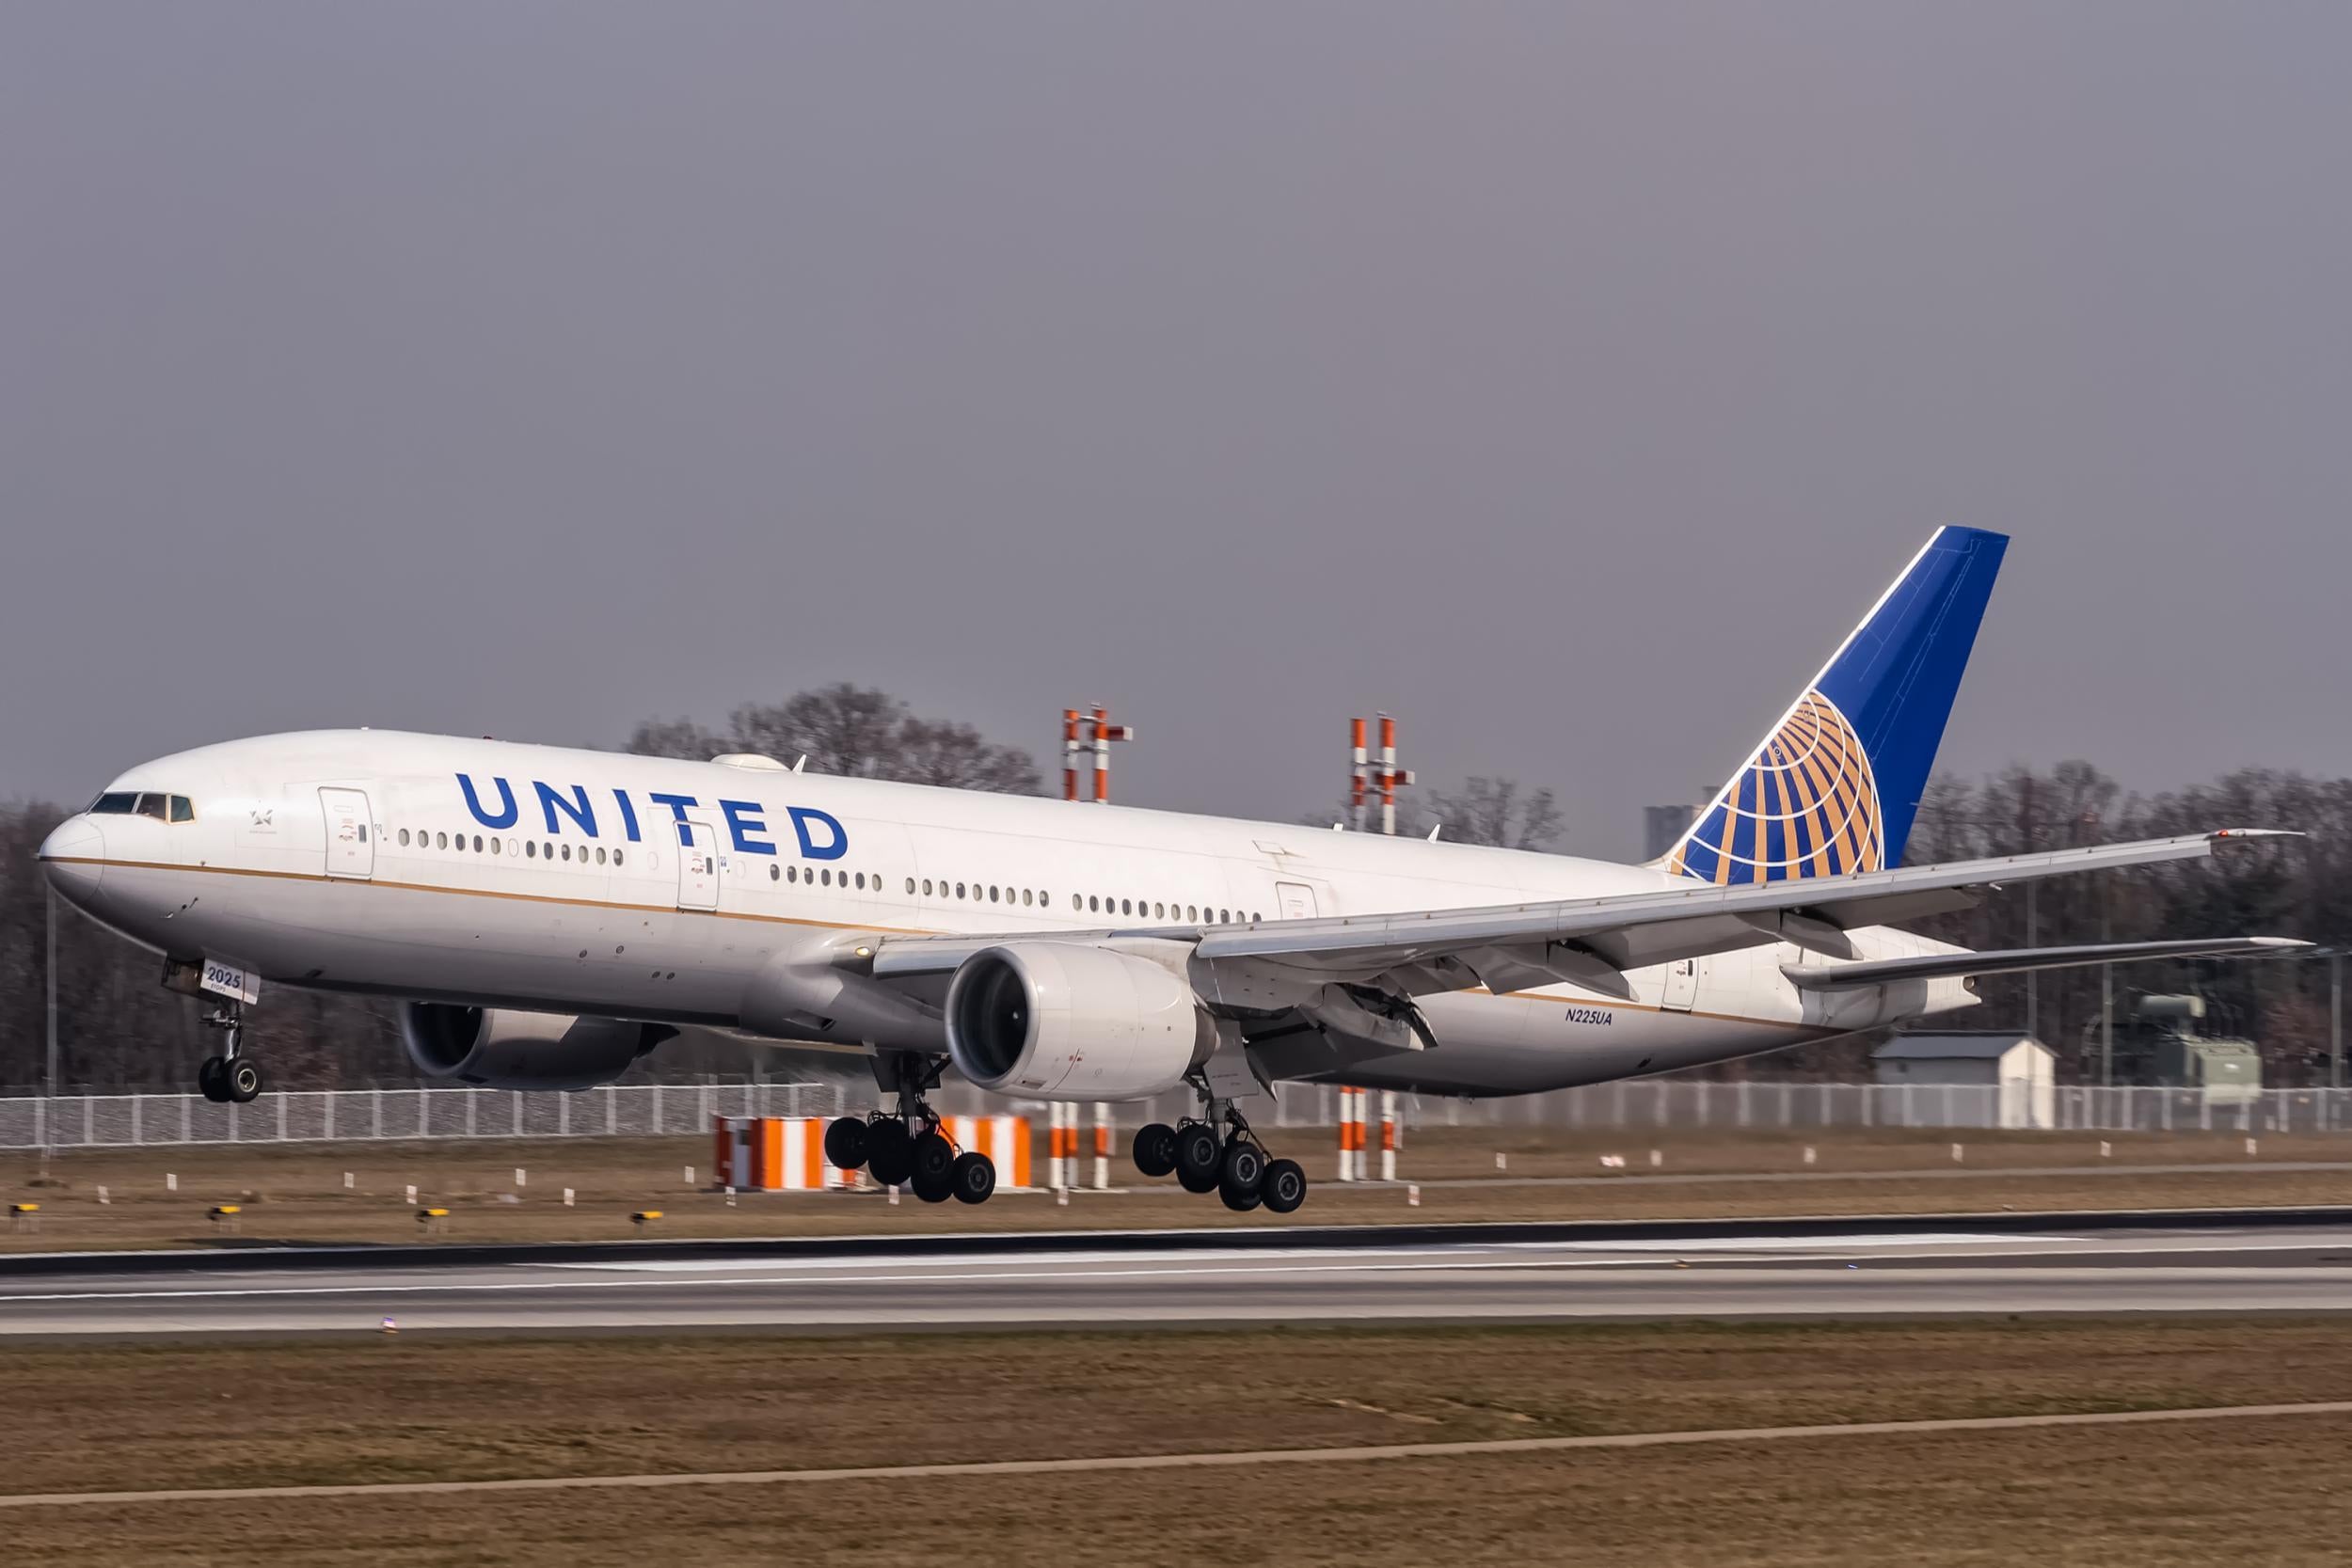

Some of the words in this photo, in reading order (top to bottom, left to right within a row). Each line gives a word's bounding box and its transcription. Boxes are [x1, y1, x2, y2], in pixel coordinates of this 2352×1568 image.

[454, 772, 849, 861] UNITED
[208, 967, 241, 989] 2025
[1565, 1008, 1612, 1026] N225UA
